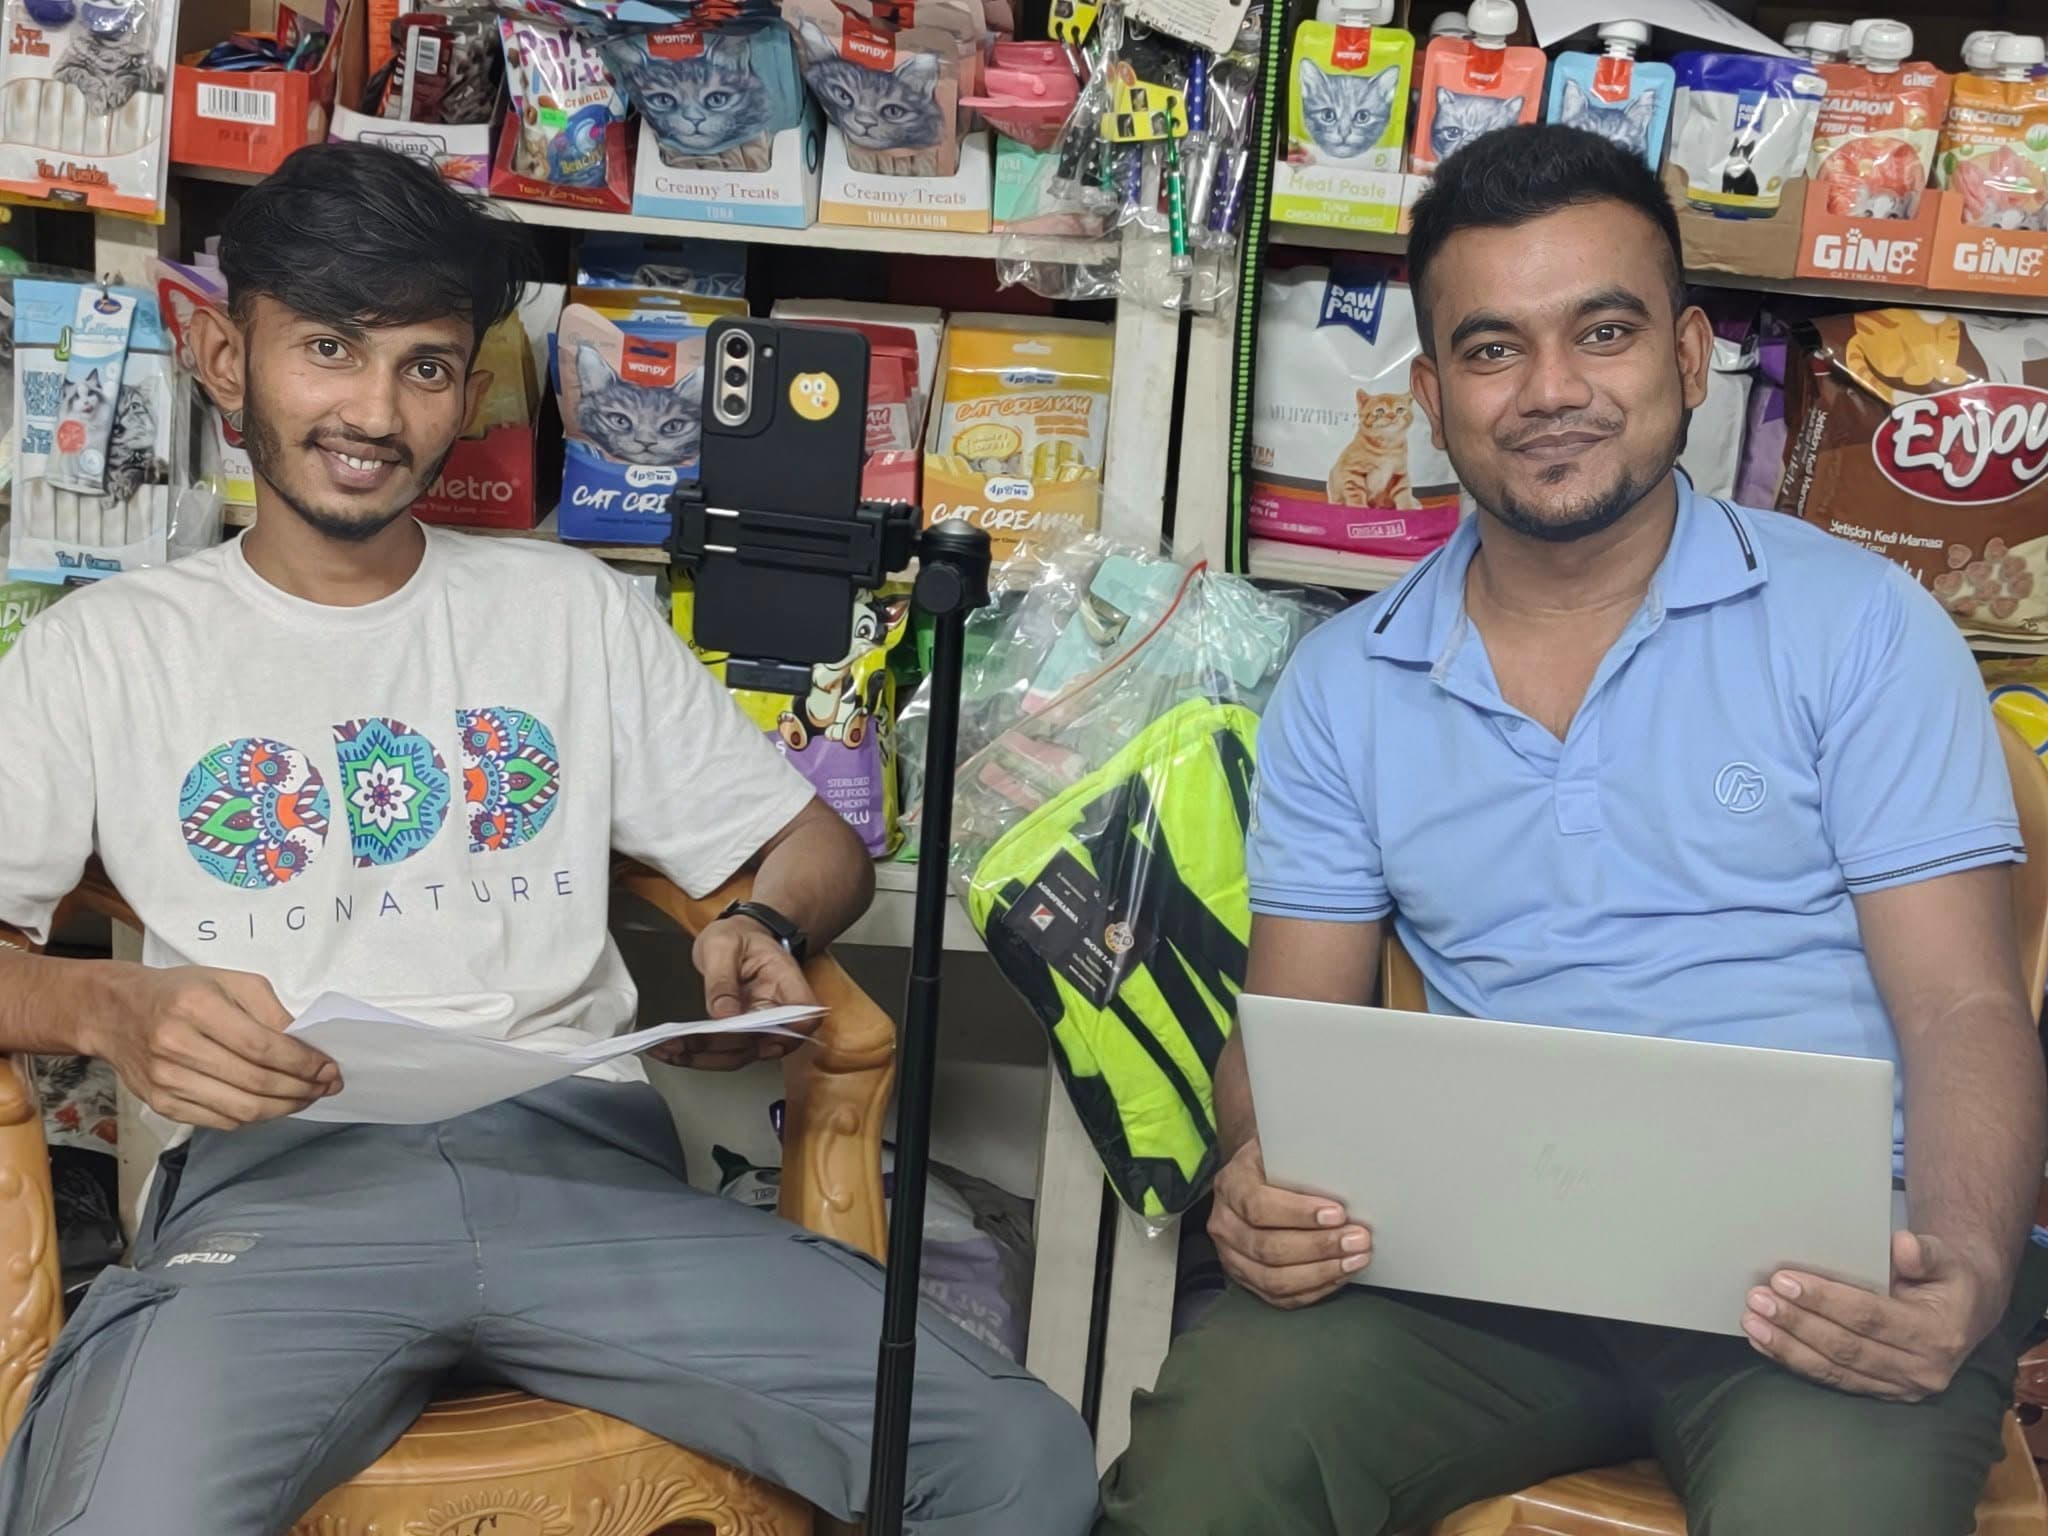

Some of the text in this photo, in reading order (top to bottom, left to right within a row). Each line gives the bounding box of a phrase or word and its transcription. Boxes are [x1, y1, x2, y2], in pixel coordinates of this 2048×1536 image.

[654, 33, 695, 45] wanpy
[849, 39, 889, 59] wanpy
[655, 177, 780, 201] Creamy Treats
[843, 183, 967, 206] Creamy Treats
[1289, 175, 1387, 198] Meat Paste
[706, 206, 734, 219] TUNA
[627, 361, 671, 376] wanpy
[955, 400, 999, 422] CAT
[1891, 399, 2048, 488] Enjoy
[572, 485, 622, 510] CAT
[931, 503, 979, 525] CAT
[1874, 529, 1898, 544] Kedi
[827, 789, 844, 799] CAT
[198, 870, 573, 941] SIGNATURE
